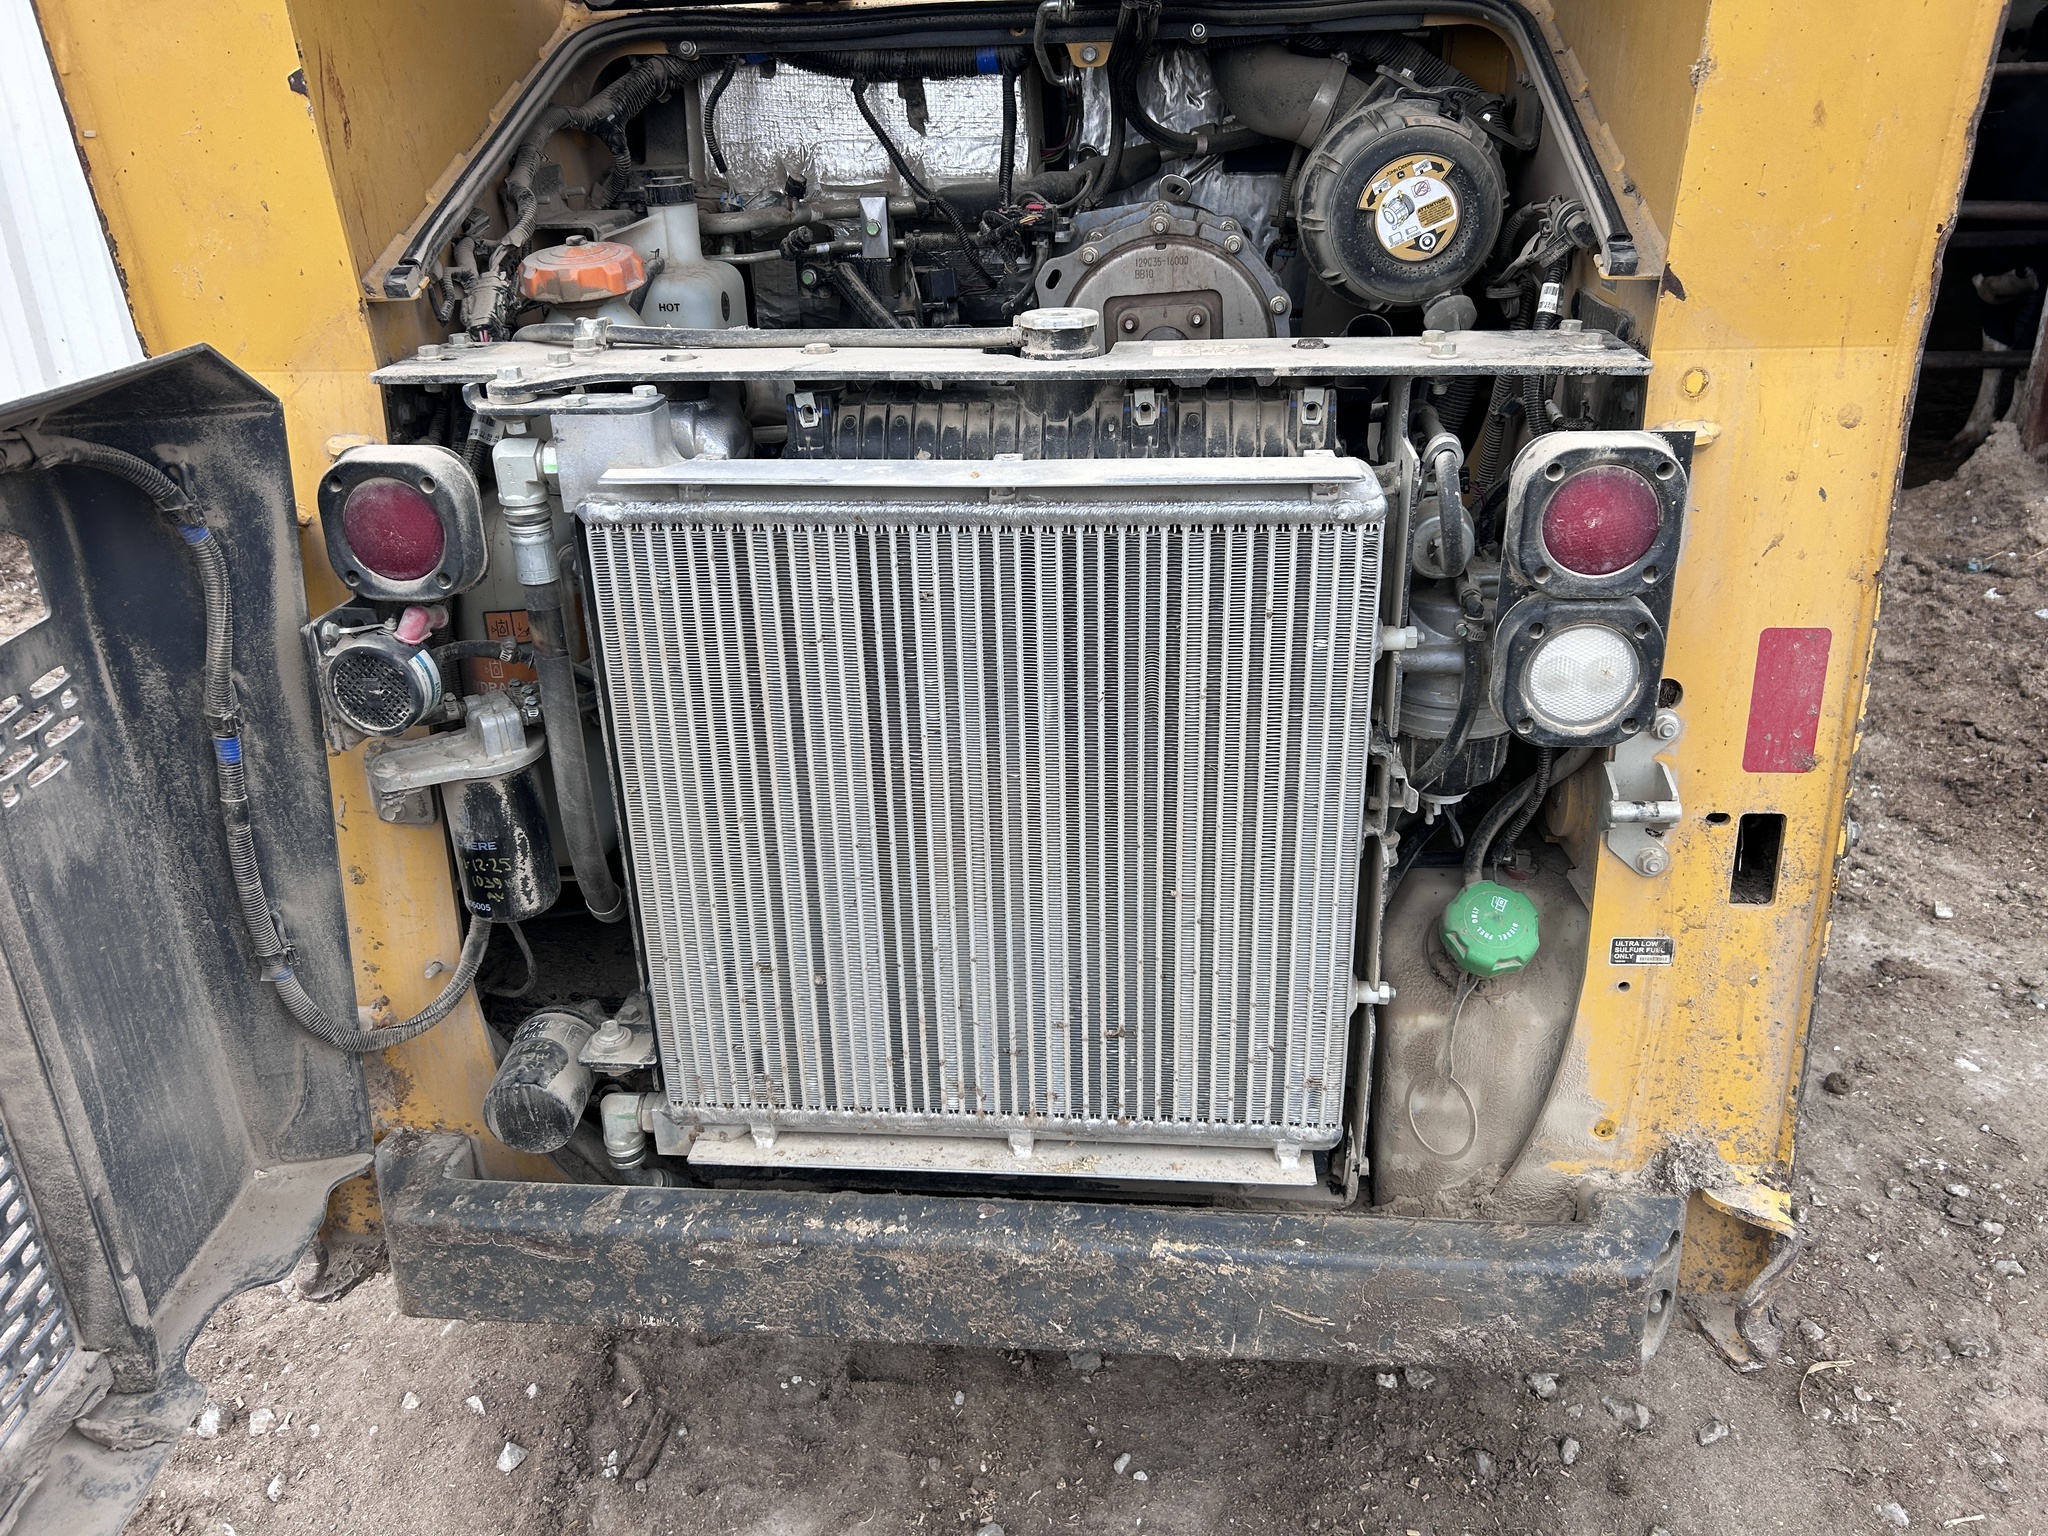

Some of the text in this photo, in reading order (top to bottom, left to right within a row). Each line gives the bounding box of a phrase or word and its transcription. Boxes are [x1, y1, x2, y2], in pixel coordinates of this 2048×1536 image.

[658, 302, 680, 312] HOT
[1471, 906, 1519, 940] DIESEL FUEL ONLY
